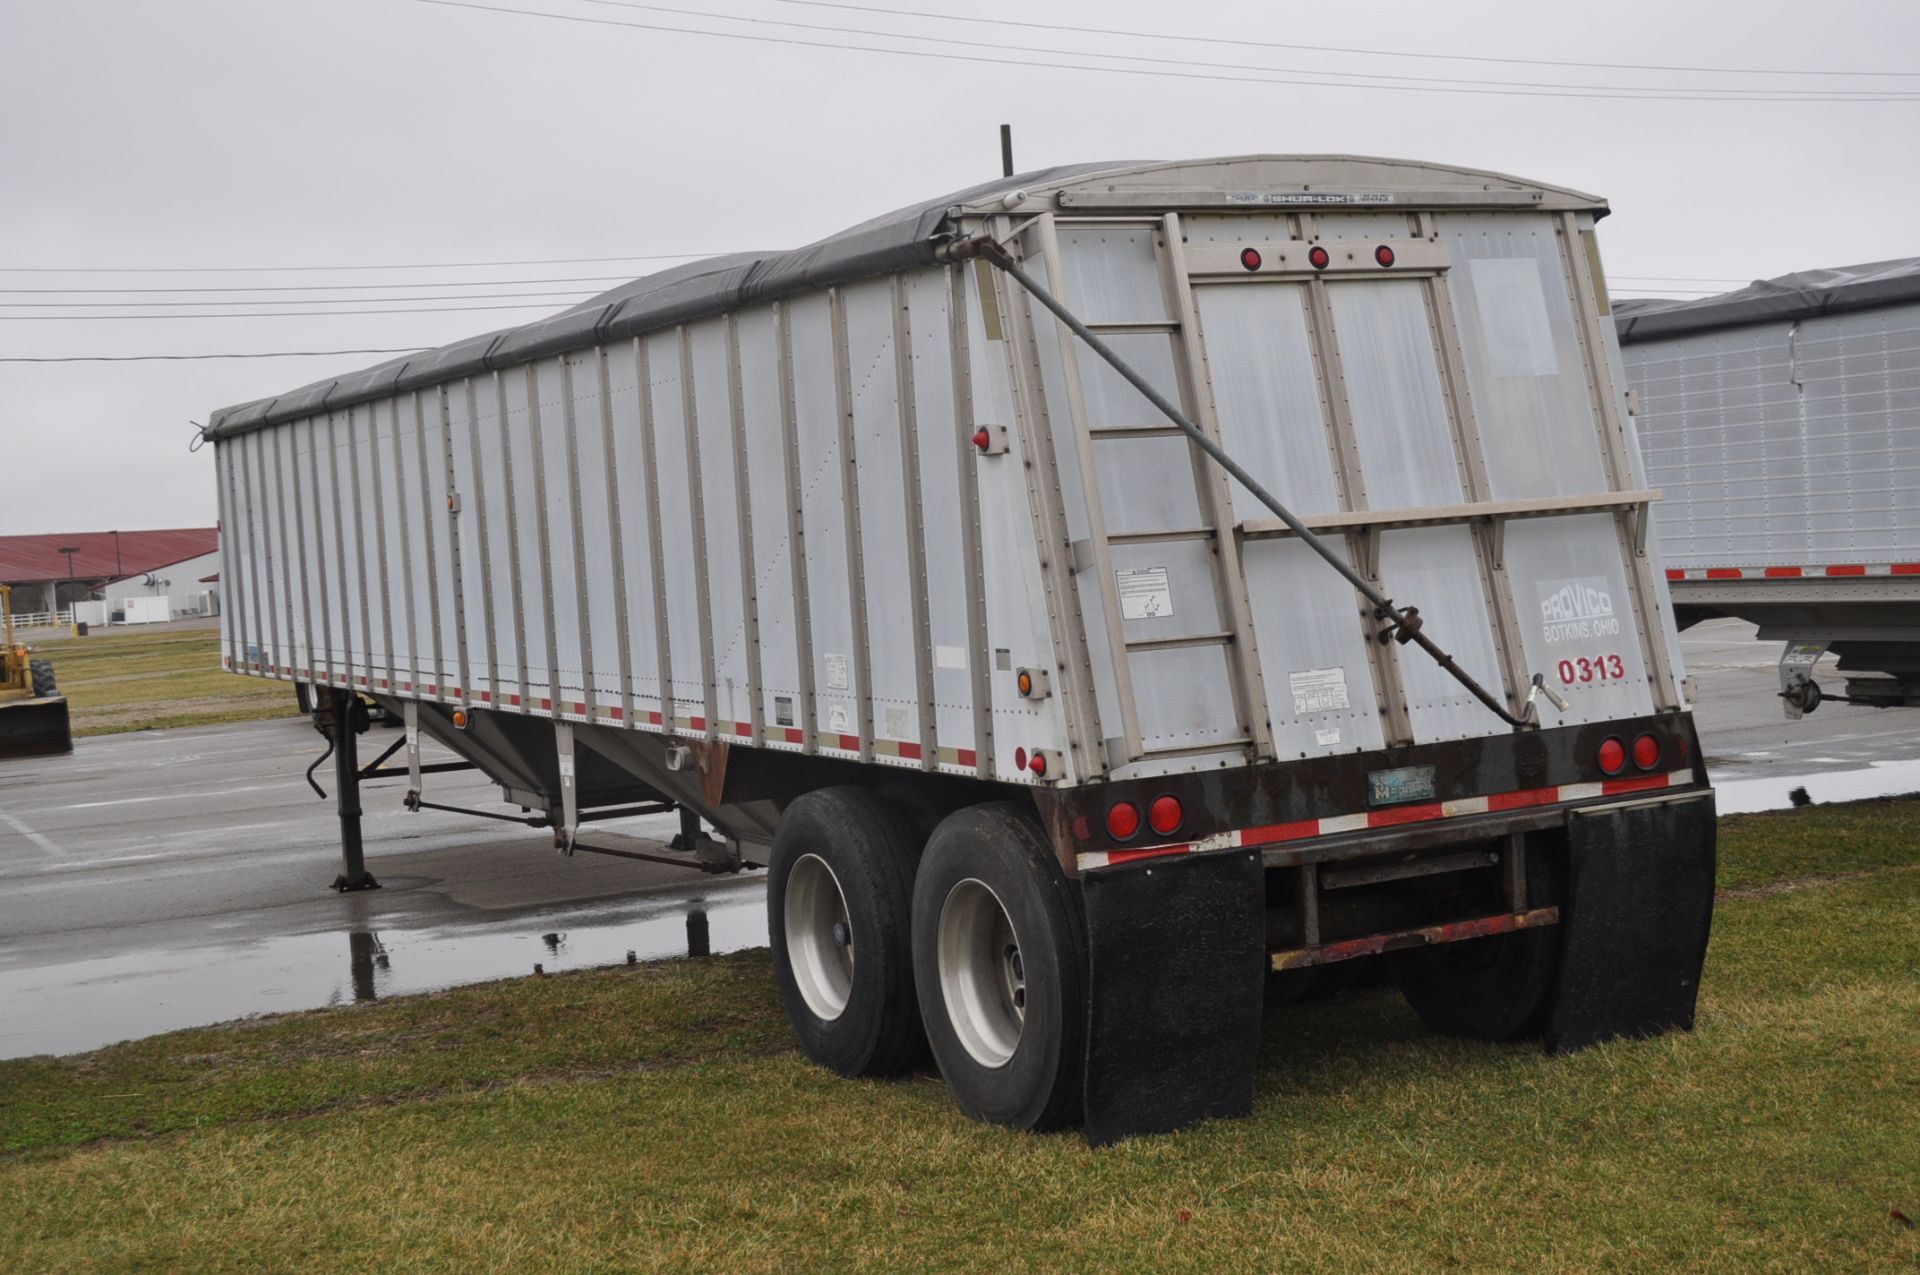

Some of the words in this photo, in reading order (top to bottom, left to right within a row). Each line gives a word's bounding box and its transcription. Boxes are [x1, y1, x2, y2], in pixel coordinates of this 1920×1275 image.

[1272, 195, 1346, 203] SHUR-LOK
[1541, 583, 1613, 621] PROVICO
[1543, 622, 1593, 642] BOTKINS,
[1593, 618, 1619, 637] OHIO
[1558, 654, 1624, 684] 0313
